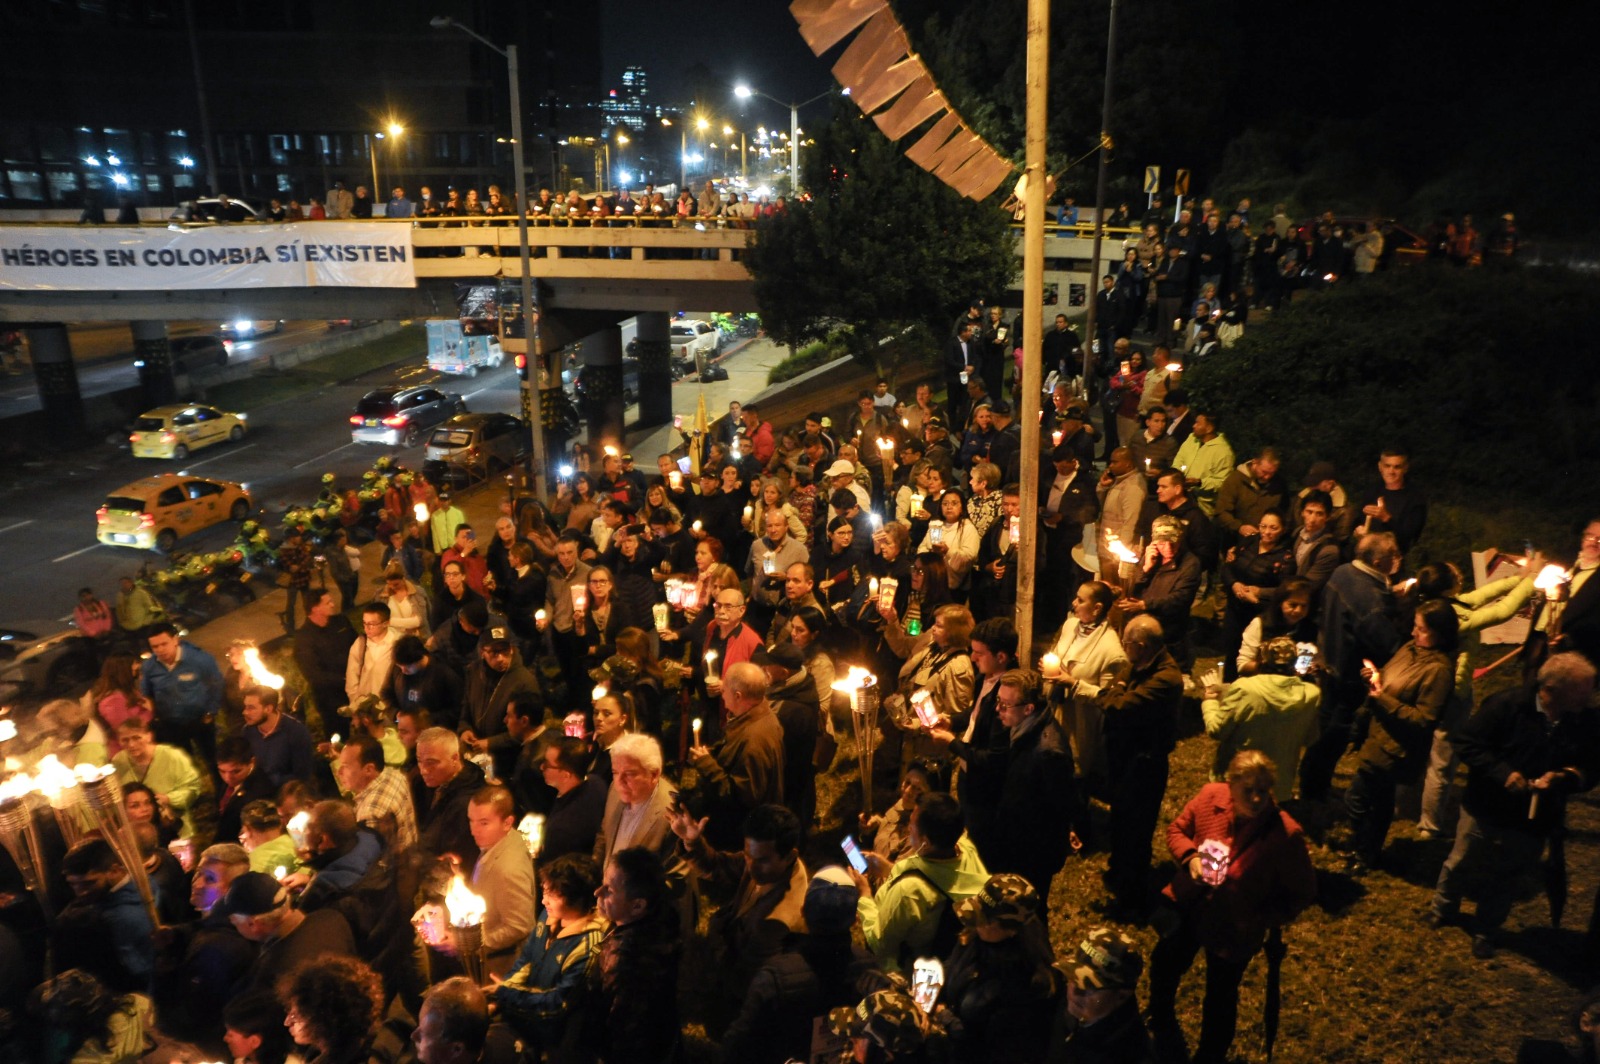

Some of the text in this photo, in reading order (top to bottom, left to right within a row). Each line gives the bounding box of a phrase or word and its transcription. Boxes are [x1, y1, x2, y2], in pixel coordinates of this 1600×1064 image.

[1, 239, 407, 267] HÉROES EN COLOMBIA SÍ EXISTEN
